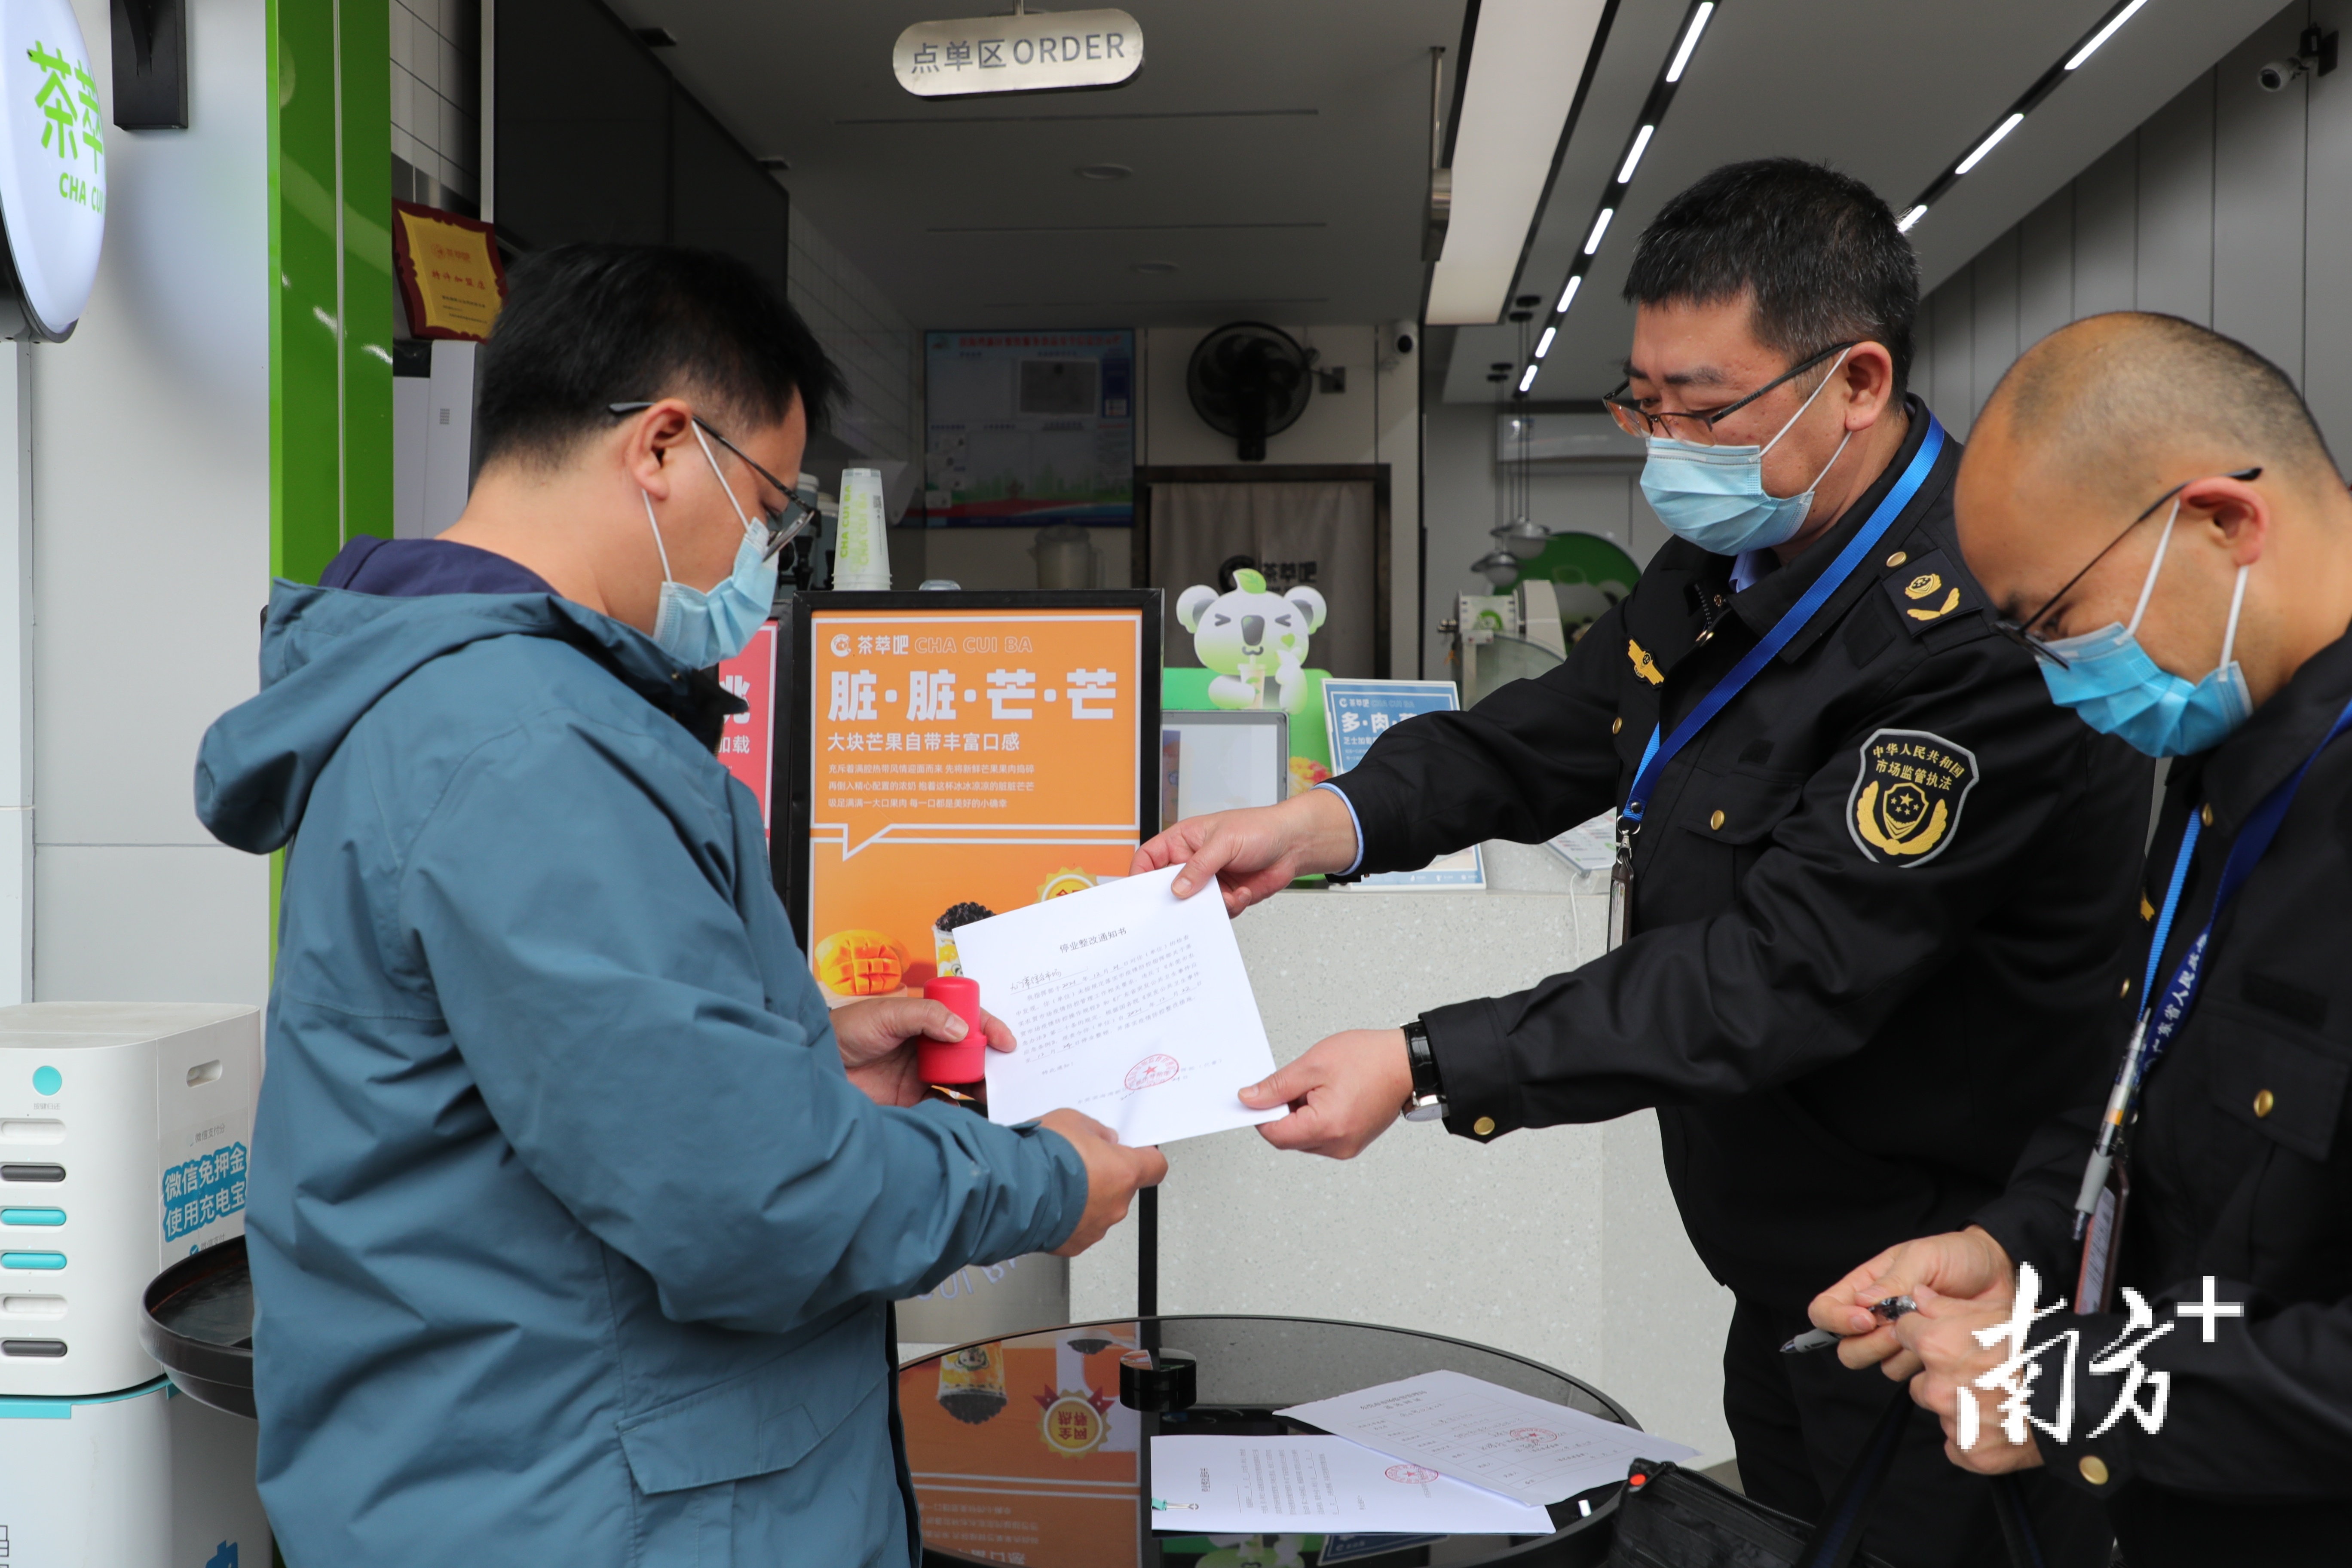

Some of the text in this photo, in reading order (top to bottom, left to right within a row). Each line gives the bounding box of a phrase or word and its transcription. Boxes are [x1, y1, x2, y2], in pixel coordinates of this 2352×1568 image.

[911, 33, 1124, 74] 点单区 ORDER
[59, 172, 103, 214] CHA CUI
[844, 485, 851, 502] BA
[840, 532, 849, 558] CHA
[858, 635, 1033, 655] 茶萃吧 CHA CUI BA
[827, 732, 1020, 752] 大块芒果自带丰富口感
[828, 764, 1035, 774] 充斥着满腔热带风情迎面而来 先将新鲜芒果果肉捣碎
[1873, 743, 1964, 778] 中华人民共和国
[828, 781, 1035, 791] 再倒入精心配置的浓奶 抱着这杯冰冰凉凉的脏脏芒芒
[1876, 760, 1952, 790] 市场监管执法
[828, 798, 1008, 808] 吸足满满一大口果肉 每一口都是美好的小确幸
[1059, 926, 1127, 953] 停业整改通知书
[195, 1123, 225, 1143] 微信支付分
[165, 1148, 245, 1202] 微信免押金
[165, 1181, 245, 1237] 使用充电宝
